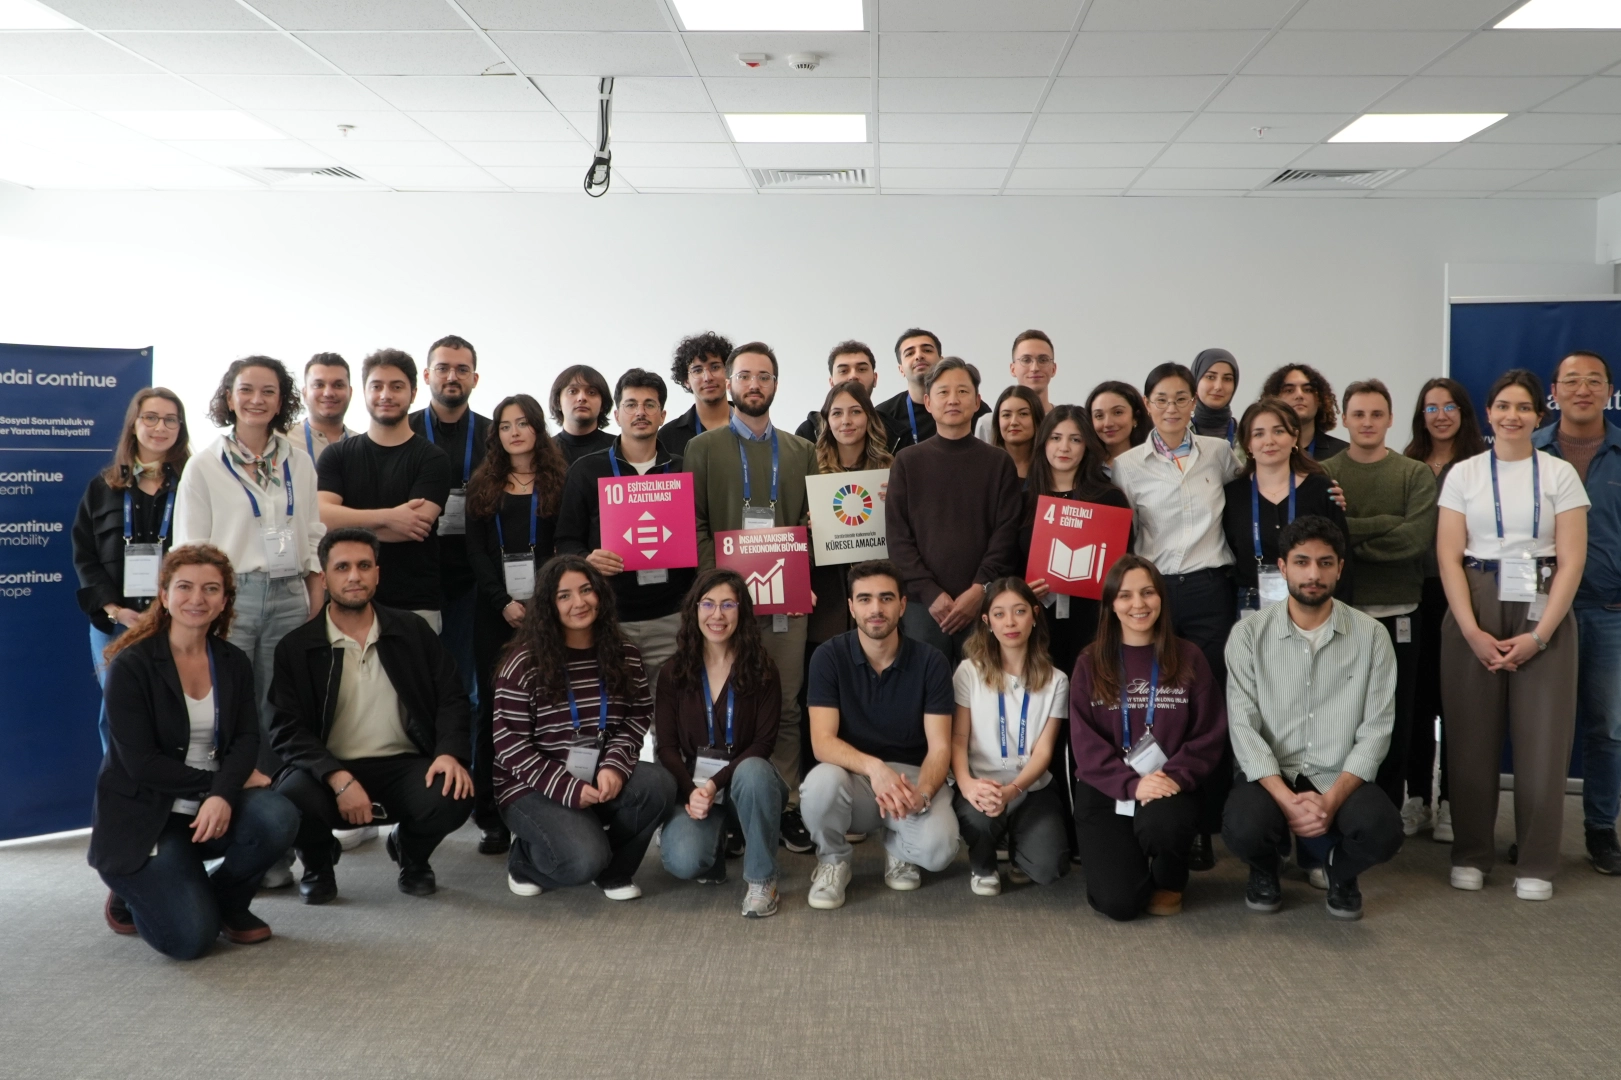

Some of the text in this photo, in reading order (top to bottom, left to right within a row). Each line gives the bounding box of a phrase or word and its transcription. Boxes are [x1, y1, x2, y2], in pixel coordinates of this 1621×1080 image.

[36, 371, 117, 388] continue
[0, 416, 30, 426] Sosyal
[31, 417, 82, 426] Sorumluluk
[10, 427, 50, 436] Yaratma
[51, 426, 91, 437] İnsiyatifi
[0, 469, 63, 483] continue
[0, 484, 33, 496] earth
[604, 484, 624, 505] 10
[628, 492, 672, 504] AZALTILMASI
[1043, 504, 1056, 524] 4
[1061, 505, 1093, 519] NİTELİKLİ
[0, 520, 63, 533] continue
[1060, 516, 1083, 529] EĞİTİM
[0, 534, 49, 547] mobility
[723, 537, 734, 555] 8
[825, 537, 886, 551] KÜRESEL AMAÇLAR
[740, 541, 808, 554] VE EKONOMİK BÜYÜME
[0, 571, 62, 584] continue
[1127, 679, 1186, 696] Haptons
